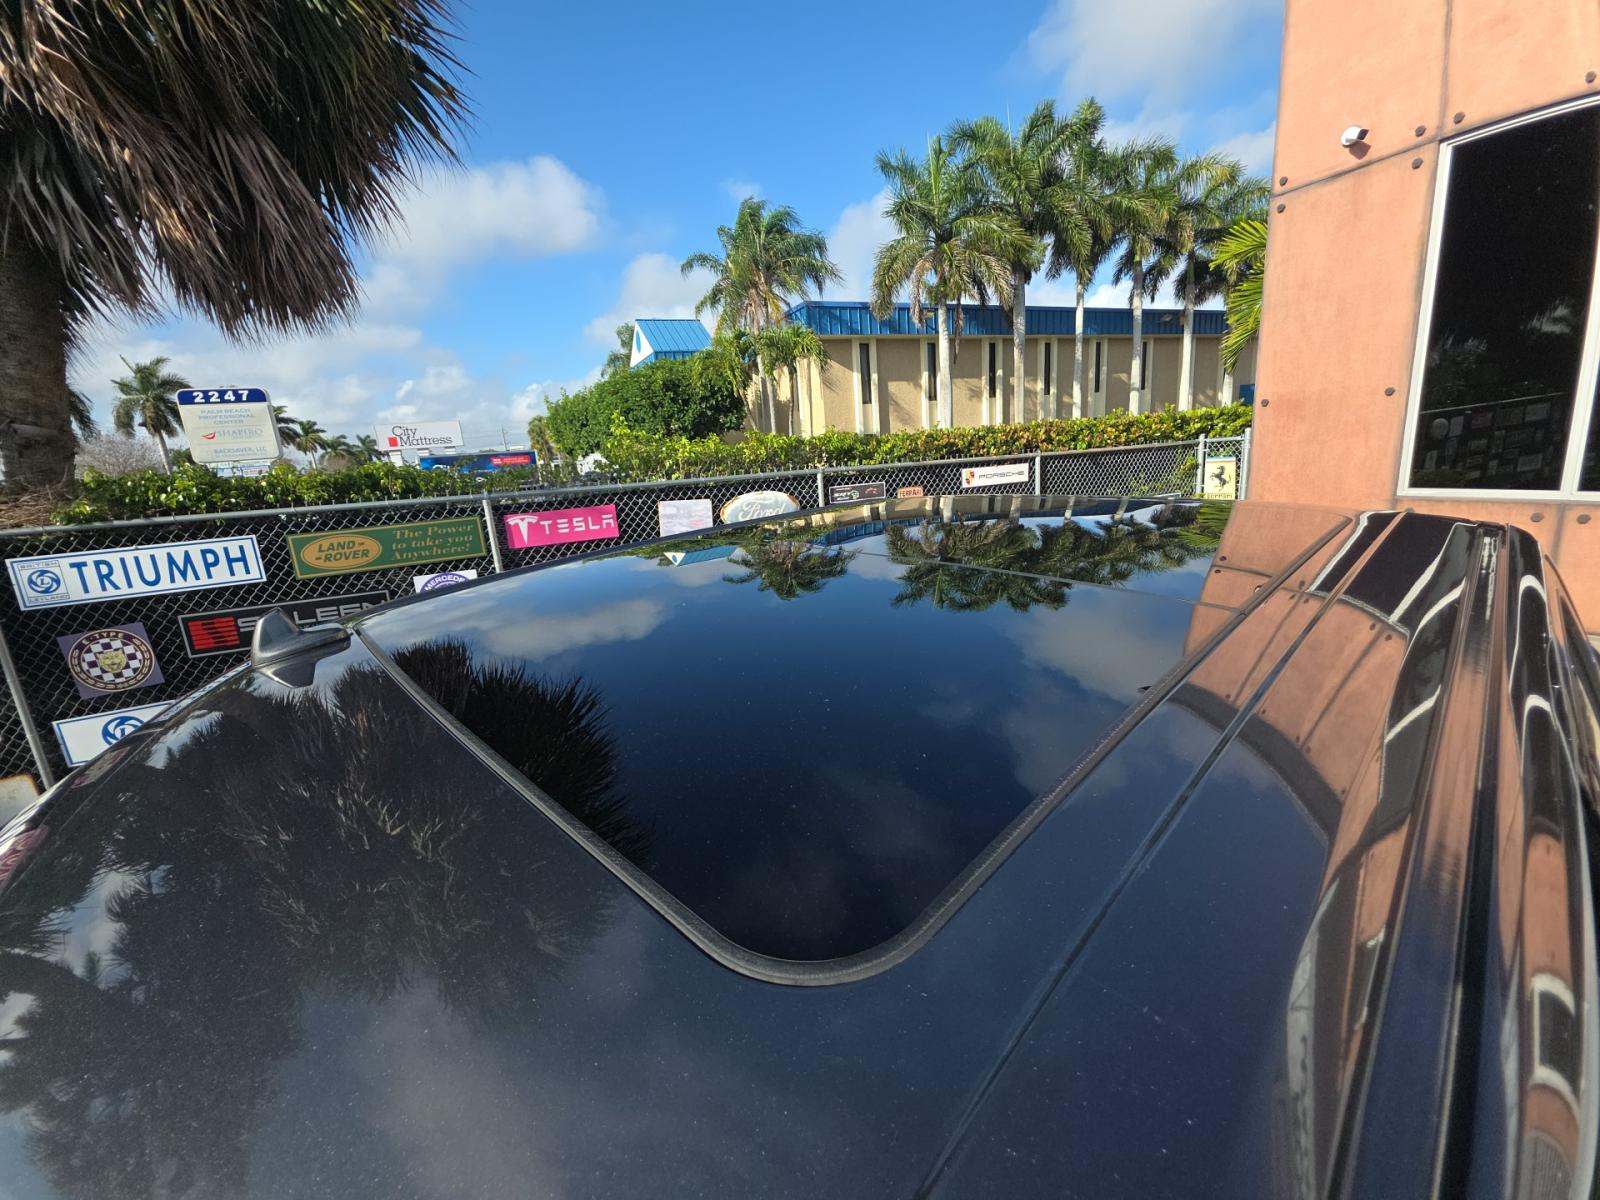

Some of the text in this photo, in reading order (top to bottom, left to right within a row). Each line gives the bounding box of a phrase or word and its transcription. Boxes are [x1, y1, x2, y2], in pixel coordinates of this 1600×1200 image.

[192, 390, 249, 403] 2247
[392, 425, 417, 438] City
[399, 436, 453, 447] Mattress
[979, 470, 1025, 480] PORSCHE
[738, 501, 787, 520] Ford
[393, 524, 474, 539] The Power
[539, 514, 615, 535] TESLA
[392, 534, 474, 549] to take you
[68, 544, 251, 594] TRIUMPH
[237, 601, 387, 632] SLEE
